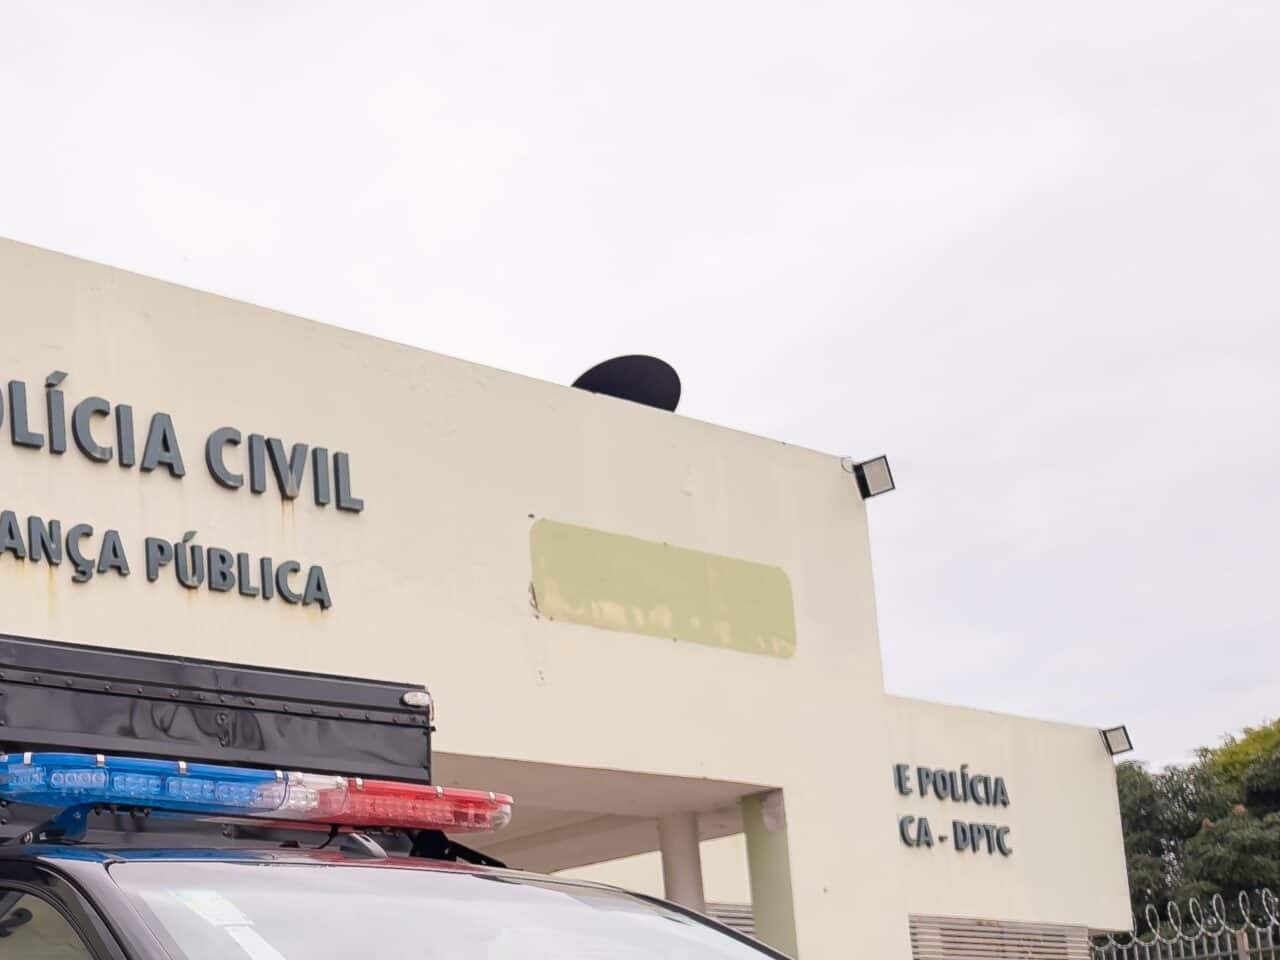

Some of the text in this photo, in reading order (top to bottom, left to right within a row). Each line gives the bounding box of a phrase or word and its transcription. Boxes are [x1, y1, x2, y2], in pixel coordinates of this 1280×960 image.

[205, 426, 364, 514] CIVIL
[145, 530, 332, 611] PÚBLICA
[917, 763, 1010, 808] POLÍCIA
[899, 815, 934, 849] CA
[952, 819, 1013, 858] DPTC
